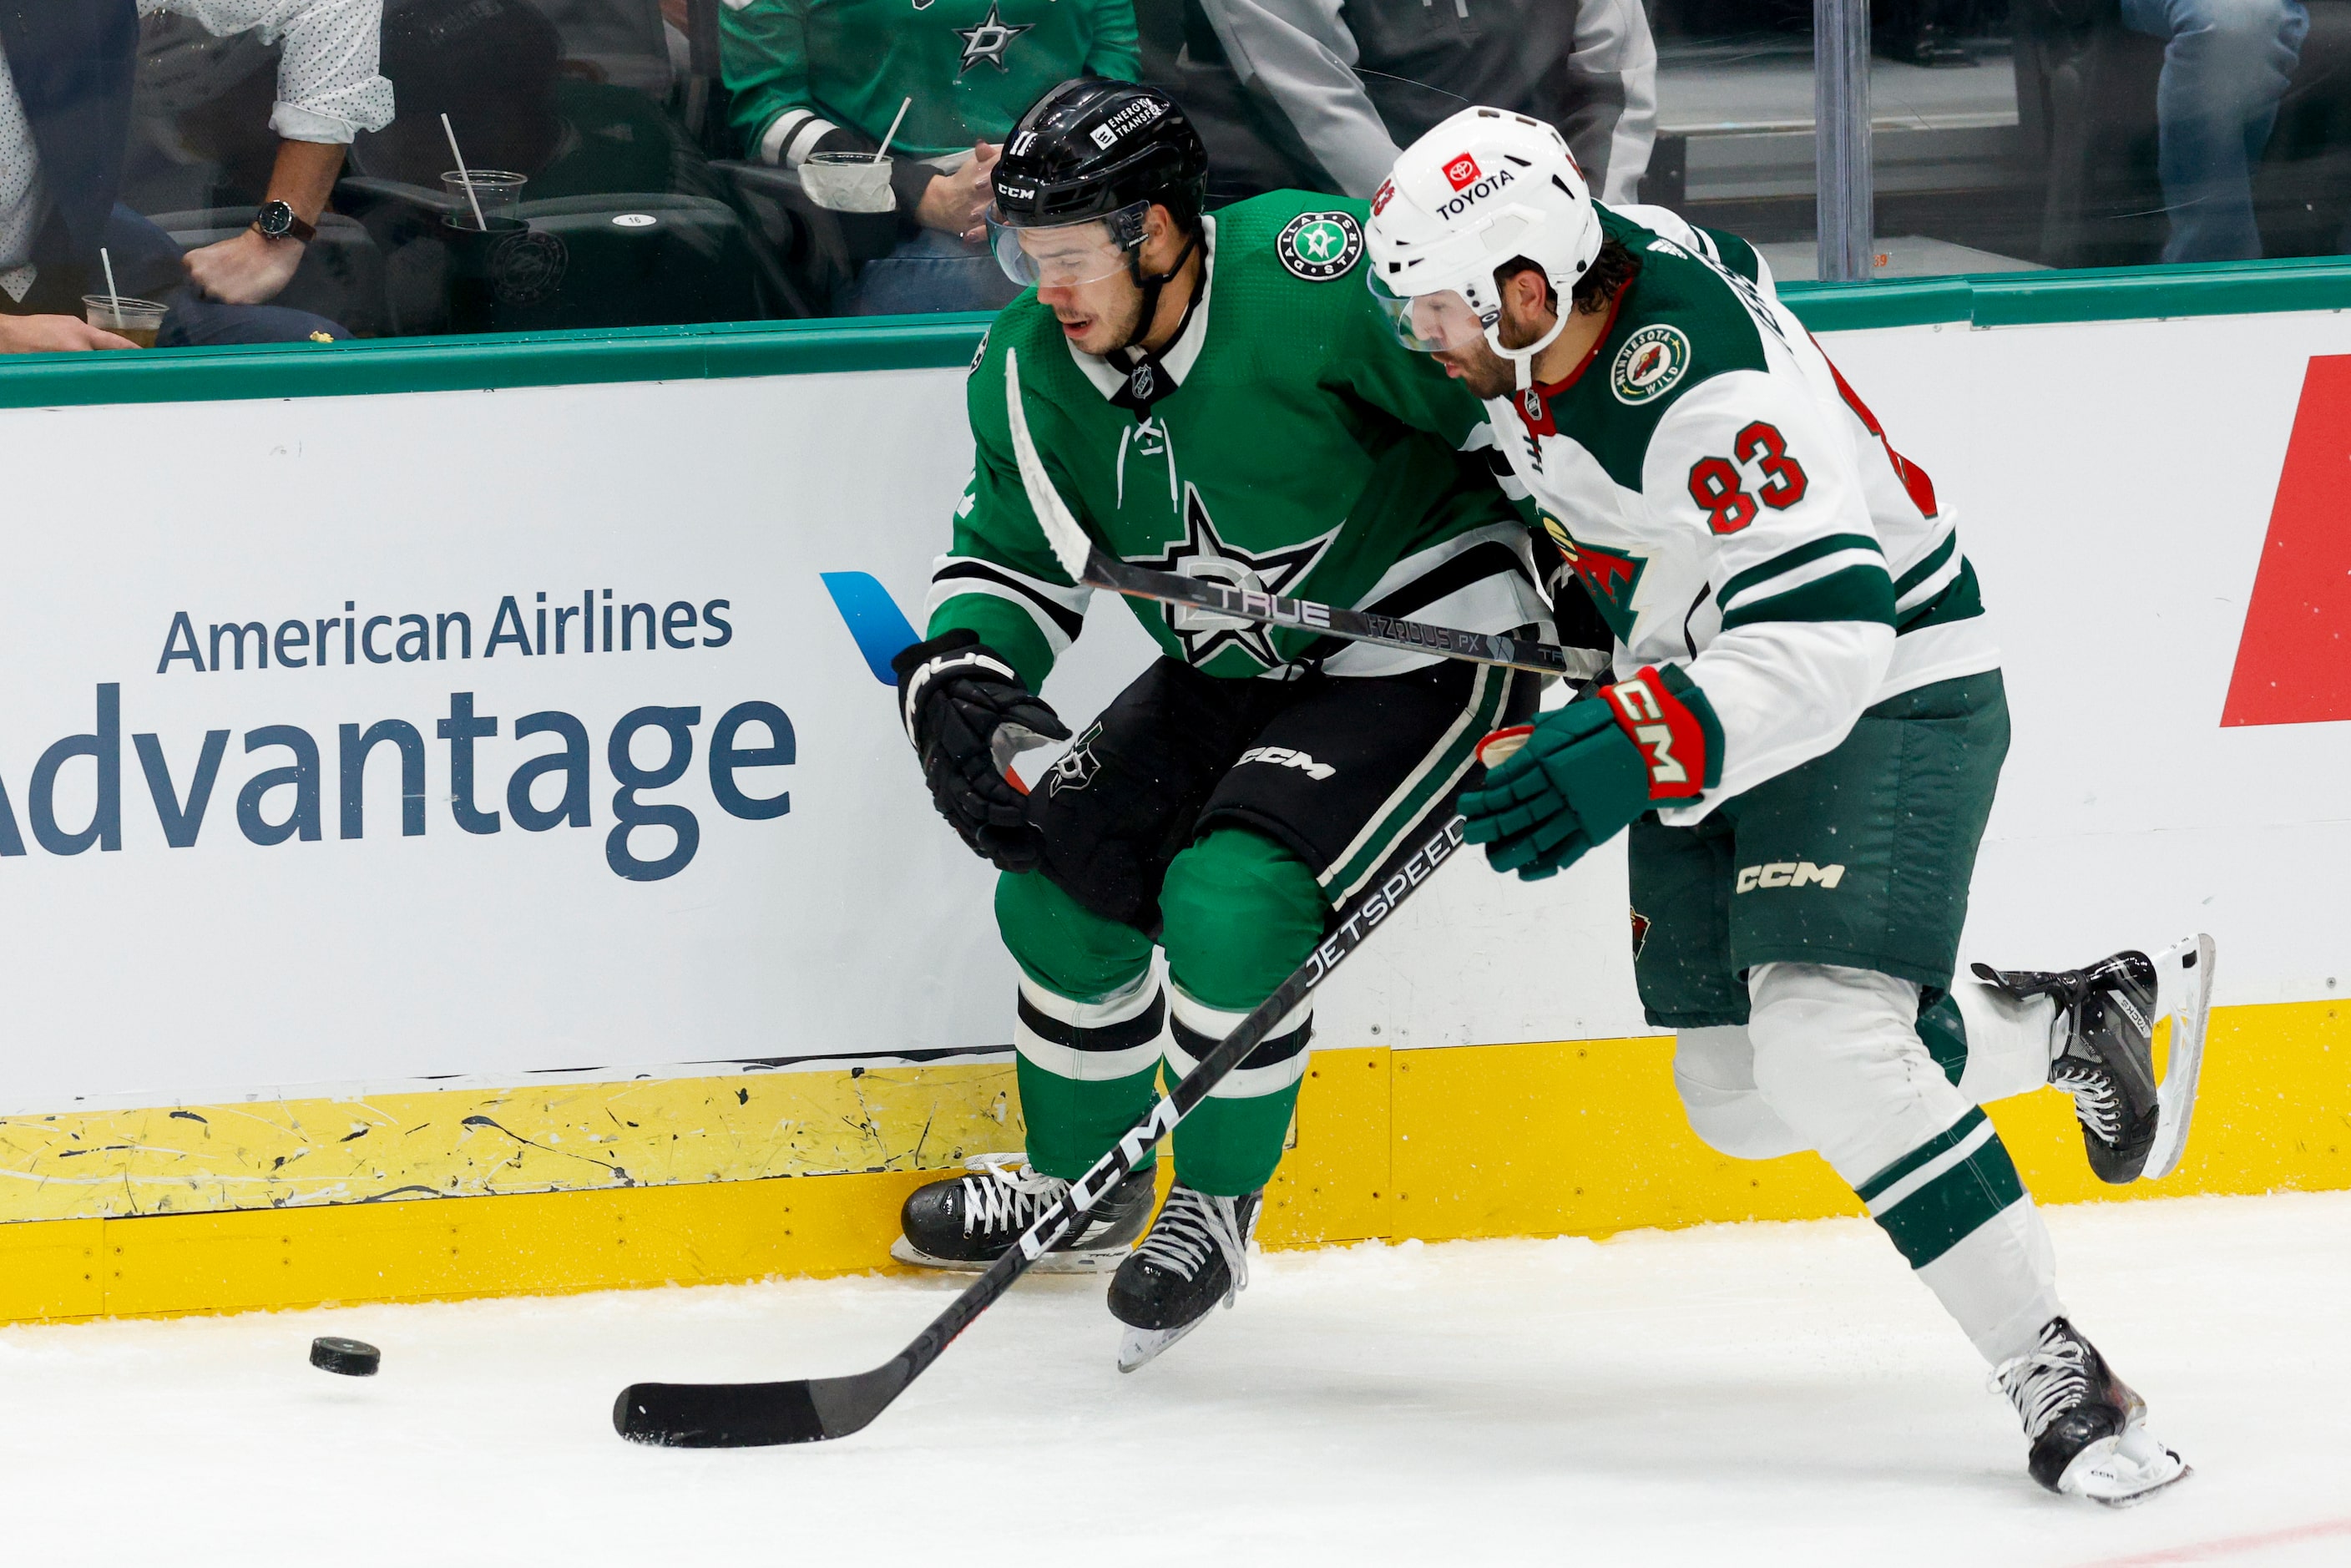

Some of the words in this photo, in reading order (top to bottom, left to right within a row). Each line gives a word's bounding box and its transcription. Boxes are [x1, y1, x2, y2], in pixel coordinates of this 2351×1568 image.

[1108, 98, 1149, 128] ENERGY
[1115, 104, 1161, 136] TRANSFER
[1009, 131, 1038, 156] 11
[999, 183, 1035, 200] CCM
[1437, 169, 1514, 220] TOYOTA
[1324, 220, 1358, 274] STARS
[1616, 330, 1671, 386] MINNESOTA
[1645, 367, 1678, 395] WILD
[1688, 420, 1808, 535] 83
[1207, 582, 1330, 628] TRUE
[157, 599, 473, 674] American
[484, 589, 733, 658] Airlines
[1459, 635, 1479, 653] PX
[1612, 678, 1689, 783] CM
[0, 682, 796, 882] dvantage
[1232, 746, 1336, 781] CCM
[1736, 862, 1845, 894] CCM
[1305, 814, 1467, 989] JETSPEED
[2121, 999, 2146, 1032] TACKS
[1019, 1095, 1181, 1262] CCM
